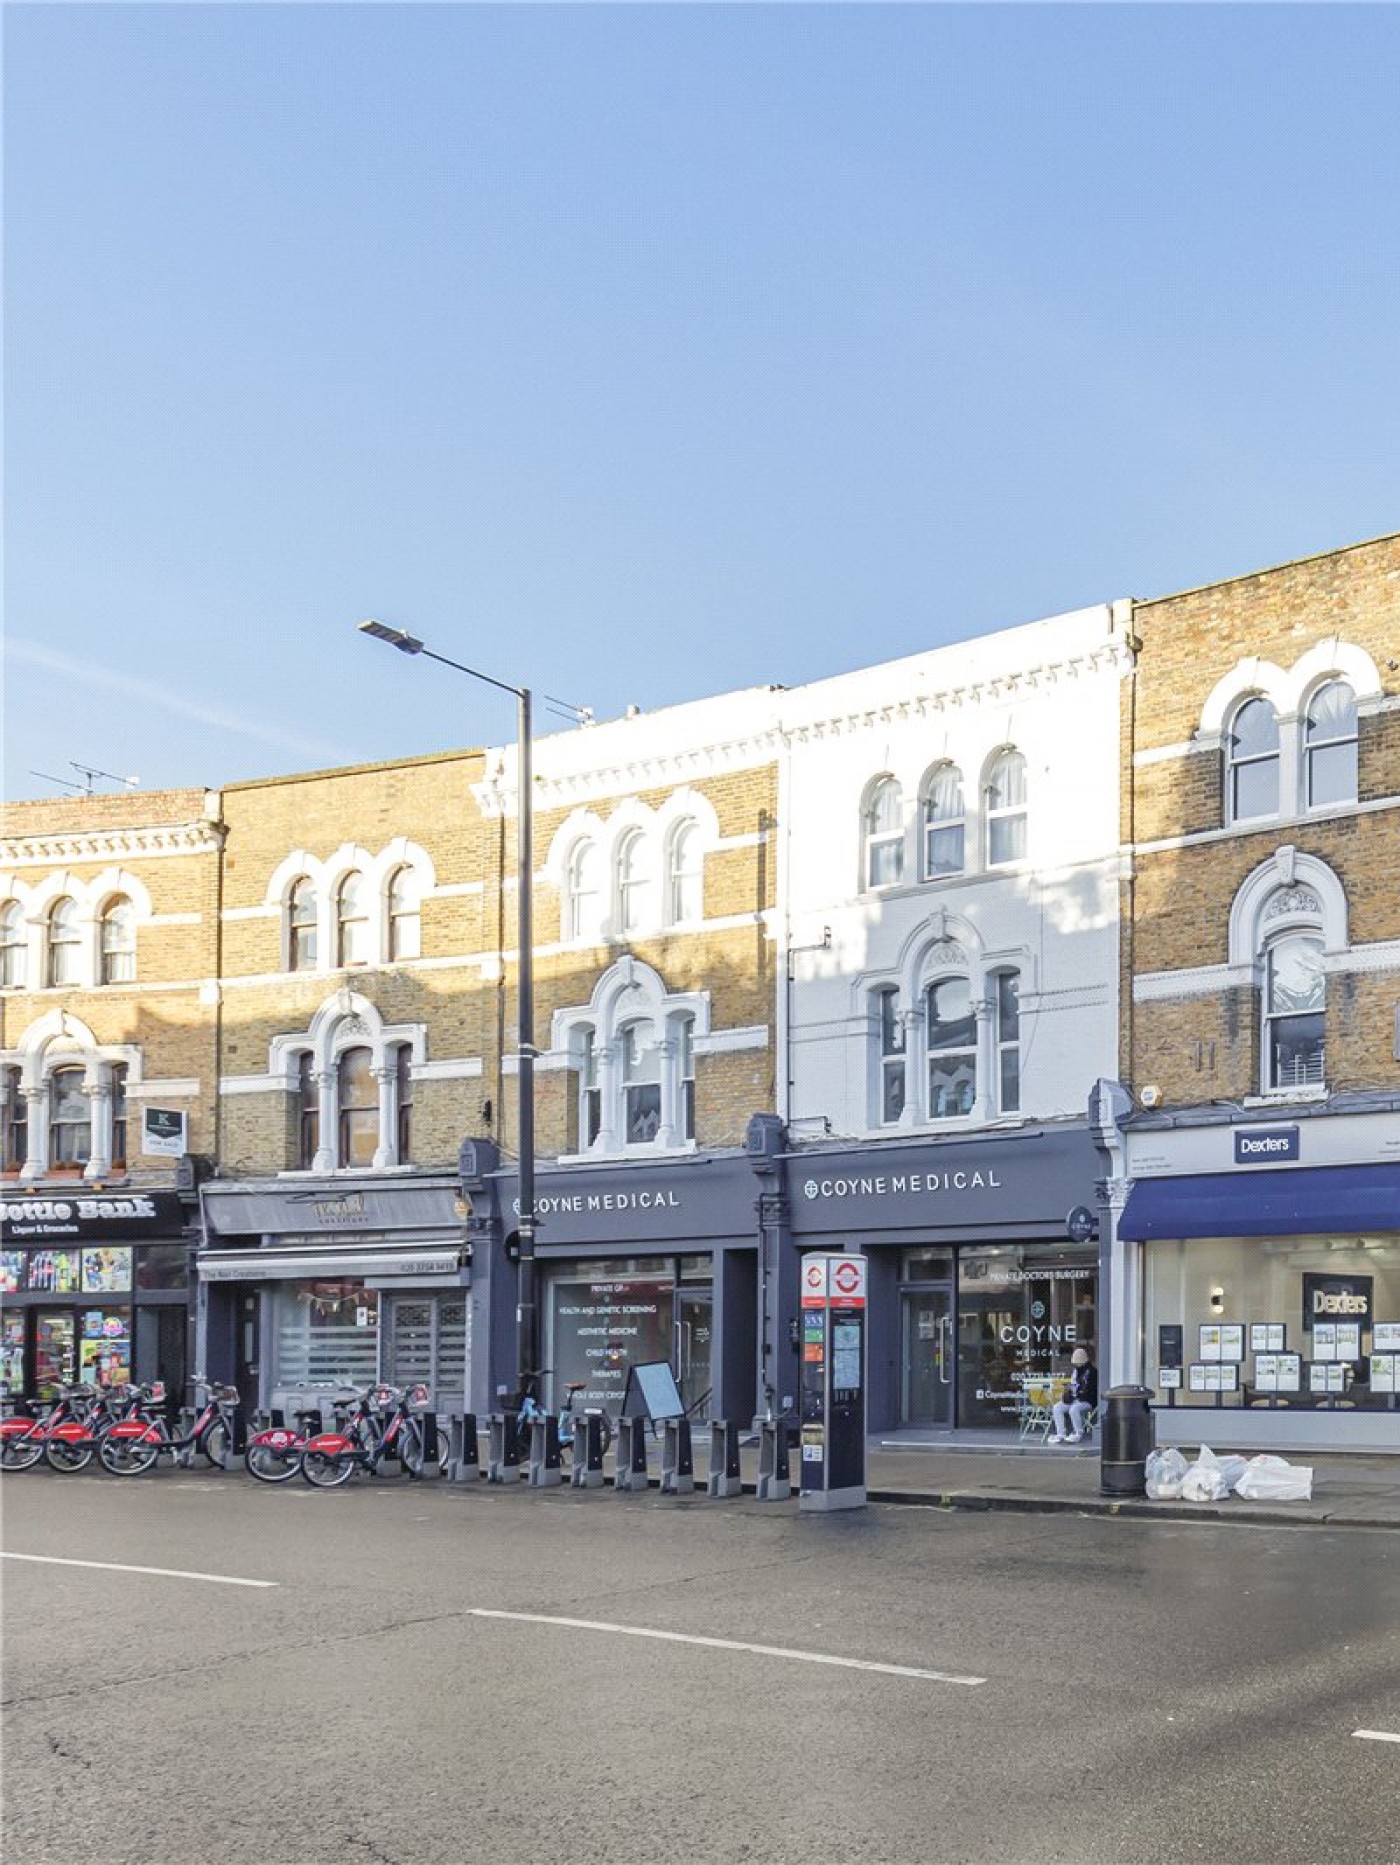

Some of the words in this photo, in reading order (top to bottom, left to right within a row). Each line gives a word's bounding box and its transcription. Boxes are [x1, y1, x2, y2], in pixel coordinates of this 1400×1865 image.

[1241, 1136, 1289, 1154] Dexters
[820, 1176, 887, 1197] COYNE
[892, 1170, 1001, 1193] MEDICAL
[77, 1198, 157, 1218] Bank
[587, 1190, 680, 1212] MEDICAL
[622, 1304, 657, 1313] SCREENING
[1313, 1290, 1368, 1314] Dexters
[1000, 1325, 1077, 1342] COYNE
[1016, 1348, 1060, 1357] MEDICAL
